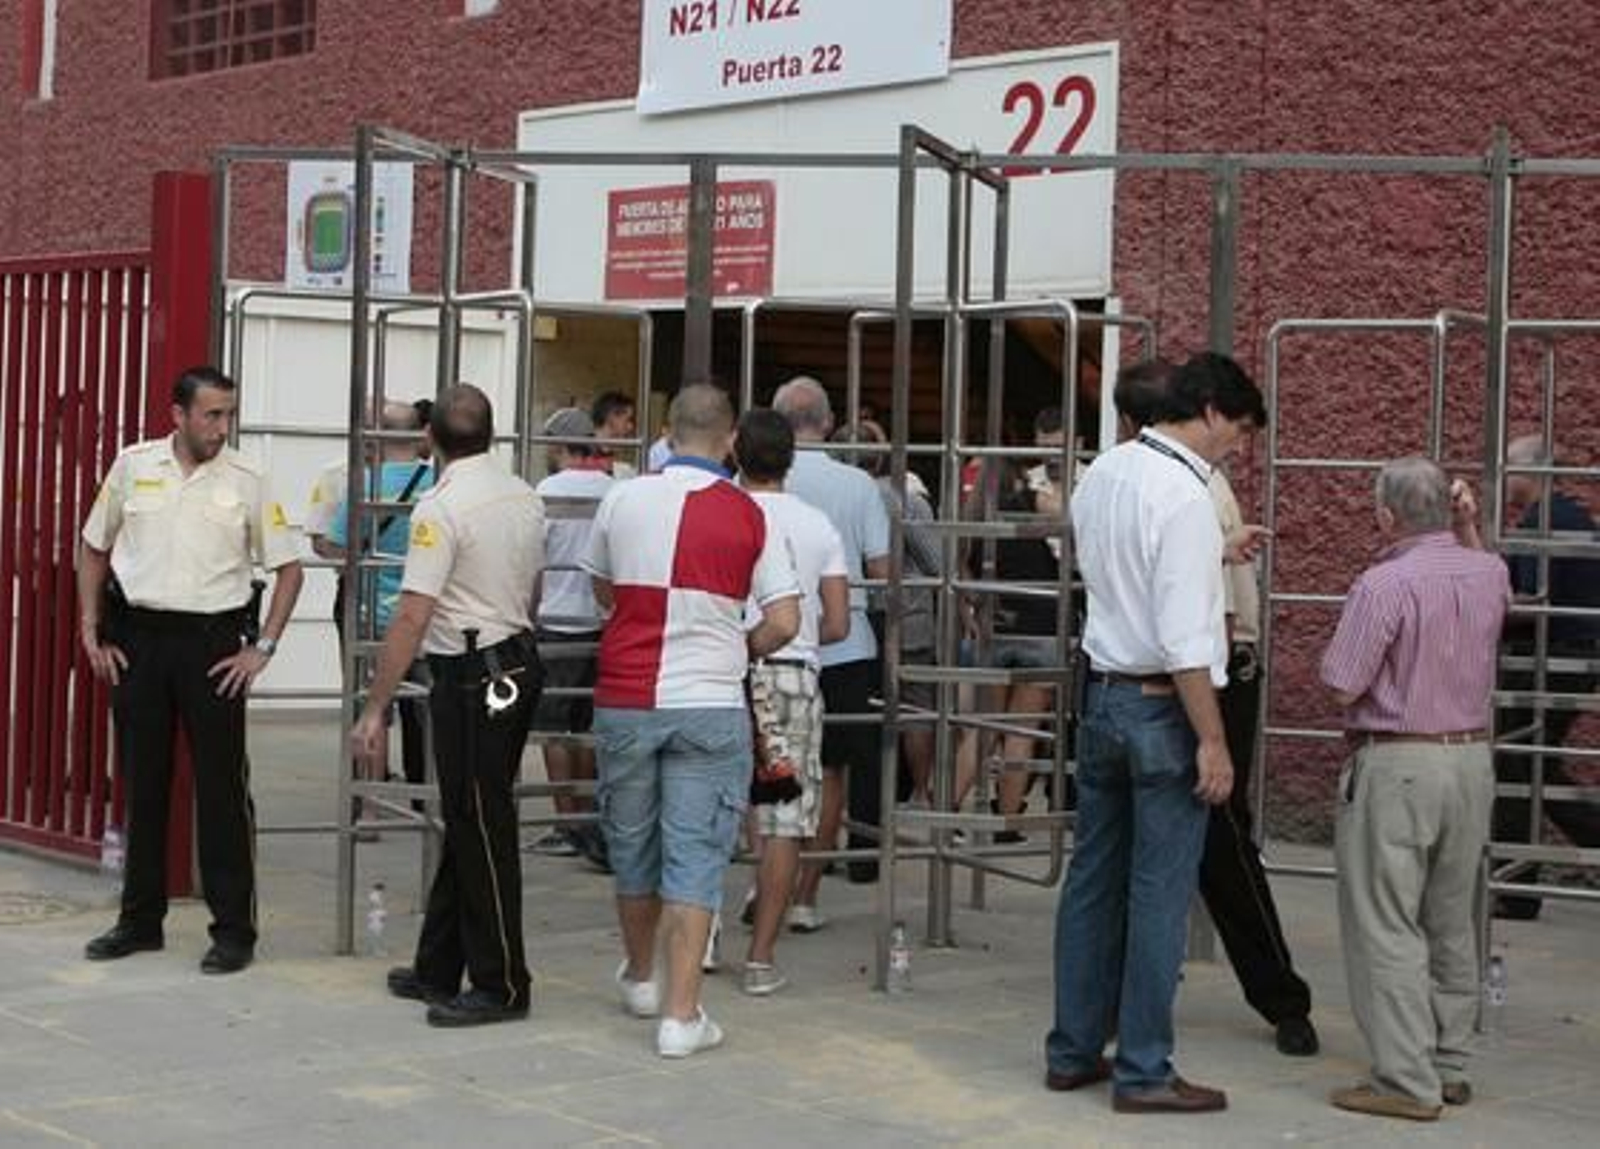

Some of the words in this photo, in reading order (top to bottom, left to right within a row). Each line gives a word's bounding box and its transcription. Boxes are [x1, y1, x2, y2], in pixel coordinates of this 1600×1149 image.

[670, 1, 718, 36] N21
[721, 54, 803, 87] Puerta
[811, 44, 843, 74] 22
[1002, 76, 1096, 177] 22
